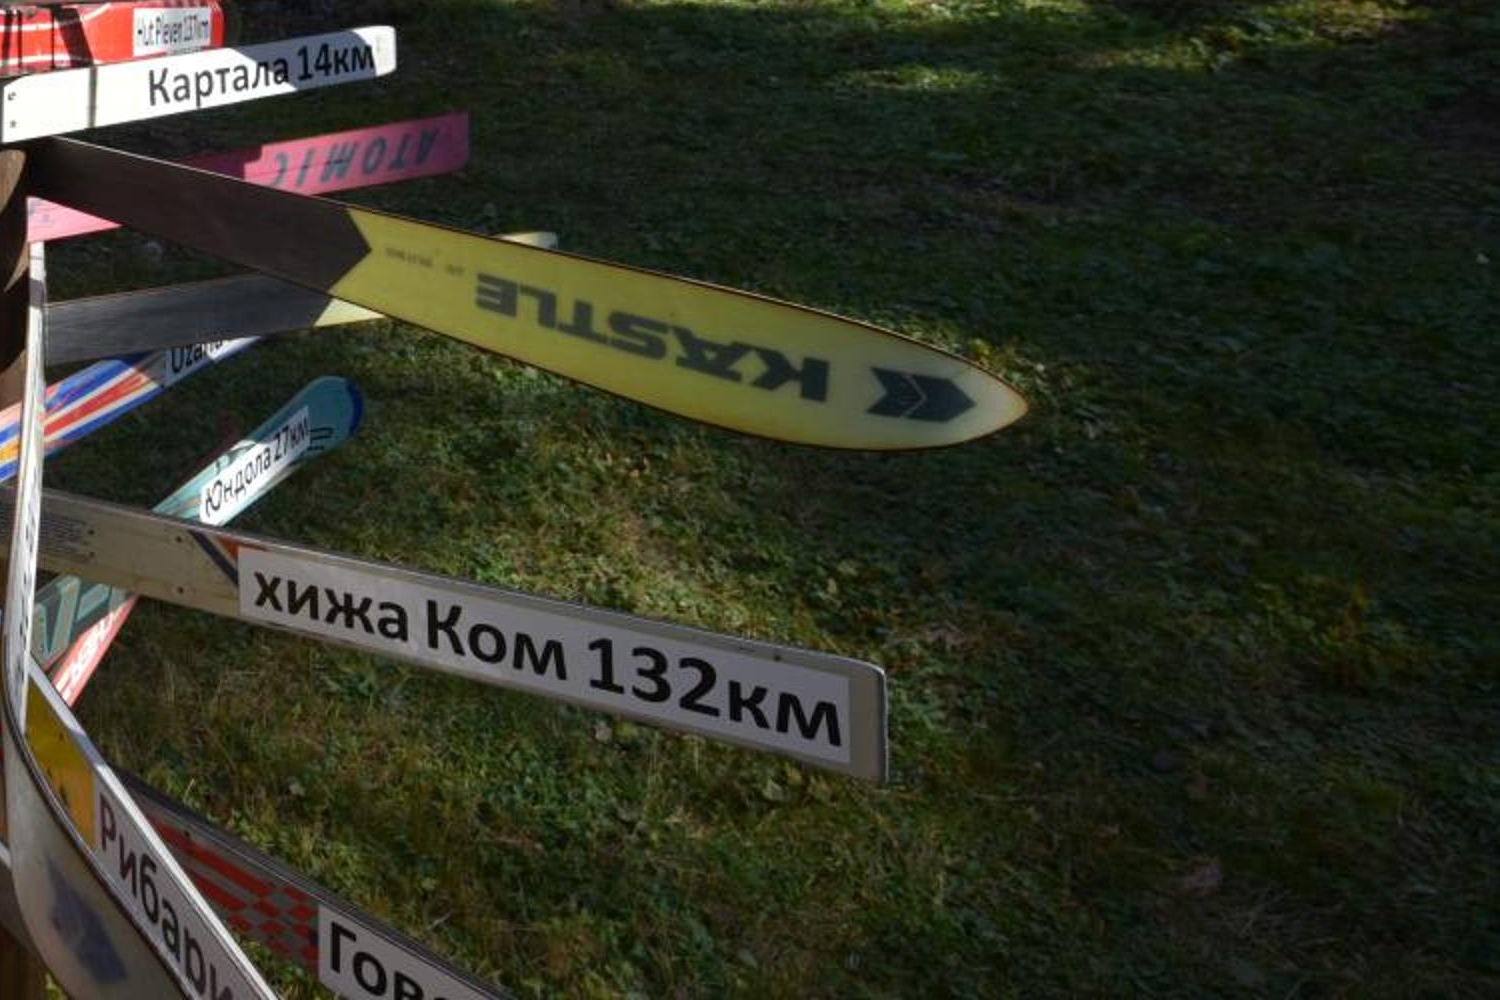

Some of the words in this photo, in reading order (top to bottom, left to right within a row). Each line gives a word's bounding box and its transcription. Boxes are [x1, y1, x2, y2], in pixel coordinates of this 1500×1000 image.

[148, 56, 289, 109] Картала
[297, 42, 376, 82] 14км
[204, 446, 271, 518] Юндола
[253, 572, 410, 642] хижа
[426, 599, 569, 682] Ком
[588, 637, 843, 748] 132км
[329, 921, 445, 1000] Гов
